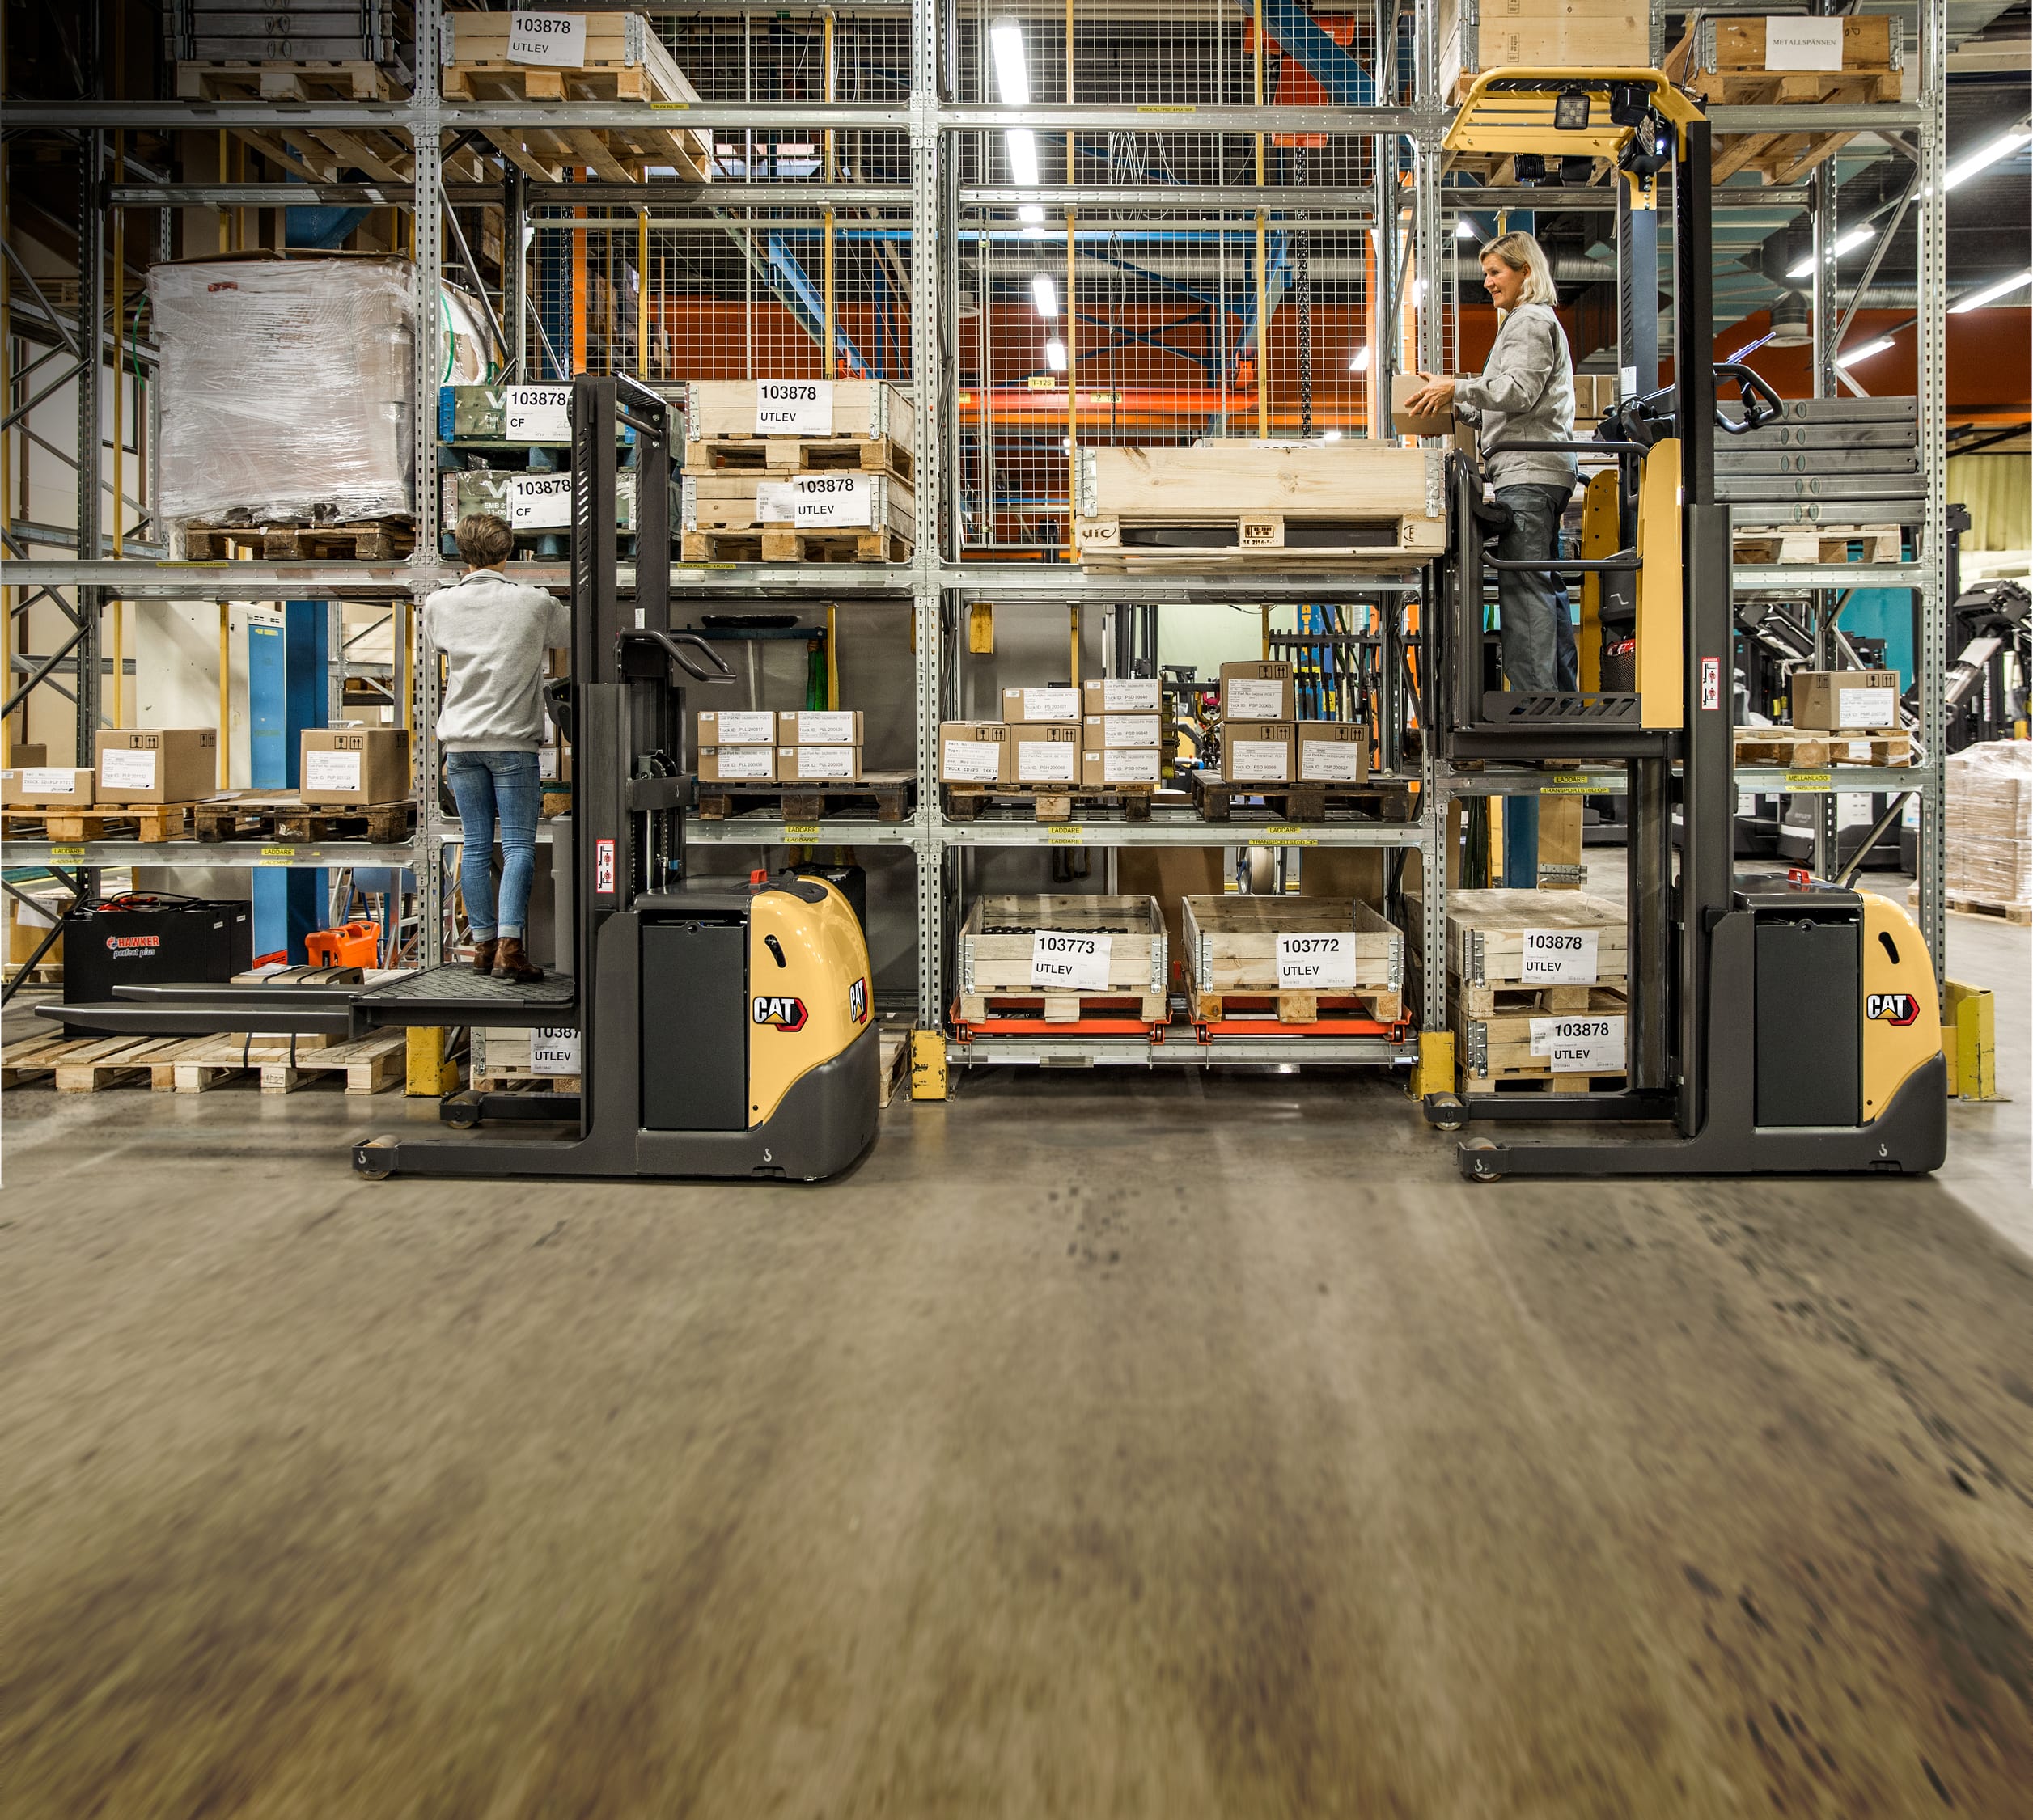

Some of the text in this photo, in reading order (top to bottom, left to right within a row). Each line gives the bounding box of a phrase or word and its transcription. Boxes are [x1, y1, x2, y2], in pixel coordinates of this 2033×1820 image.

[515, 19, 570, 34] 103878
[512, 42, 549, 53] UTLEV
[1773, 38, 1836, 46] METALLSPÄNNEN
[511, 392, 566, 405] 103878
[760, 386, 816, 400] 103878
[760, 412, 797, 421] UTLEV
[510, 418, 525, 428] CF
[517, 479, 571, 496] 103878
[798, 478, 854, 493] 103878
[516, 507, 531, 517] CF
[798, 506, 835, 514] UTLEV
[118, 936, 160, 948] HAWKER
[1039, 937, 1095, 954] 103773
[1283, 938, 1340, 953] 103772
[1527, 935, 1582, 950] 103878
[113, 948, 155, 959] perfect plus
[1036, 963, 1073, 975] UTLEV
[1283, 966, 1319, 976] UTLEV
[1526, 961, 1561, 971] UTLEV
[850, 979, 864, 1022] CAT
[1867, 995, 1907, 1018] CAT
[753, 997, 795, 1024] CAT
[1555, 1022, 1609, 1036] 103878
[535, 1052, 571, 1061] UTLEV
[1554, 1049, 1590, 1060] UTLEV
